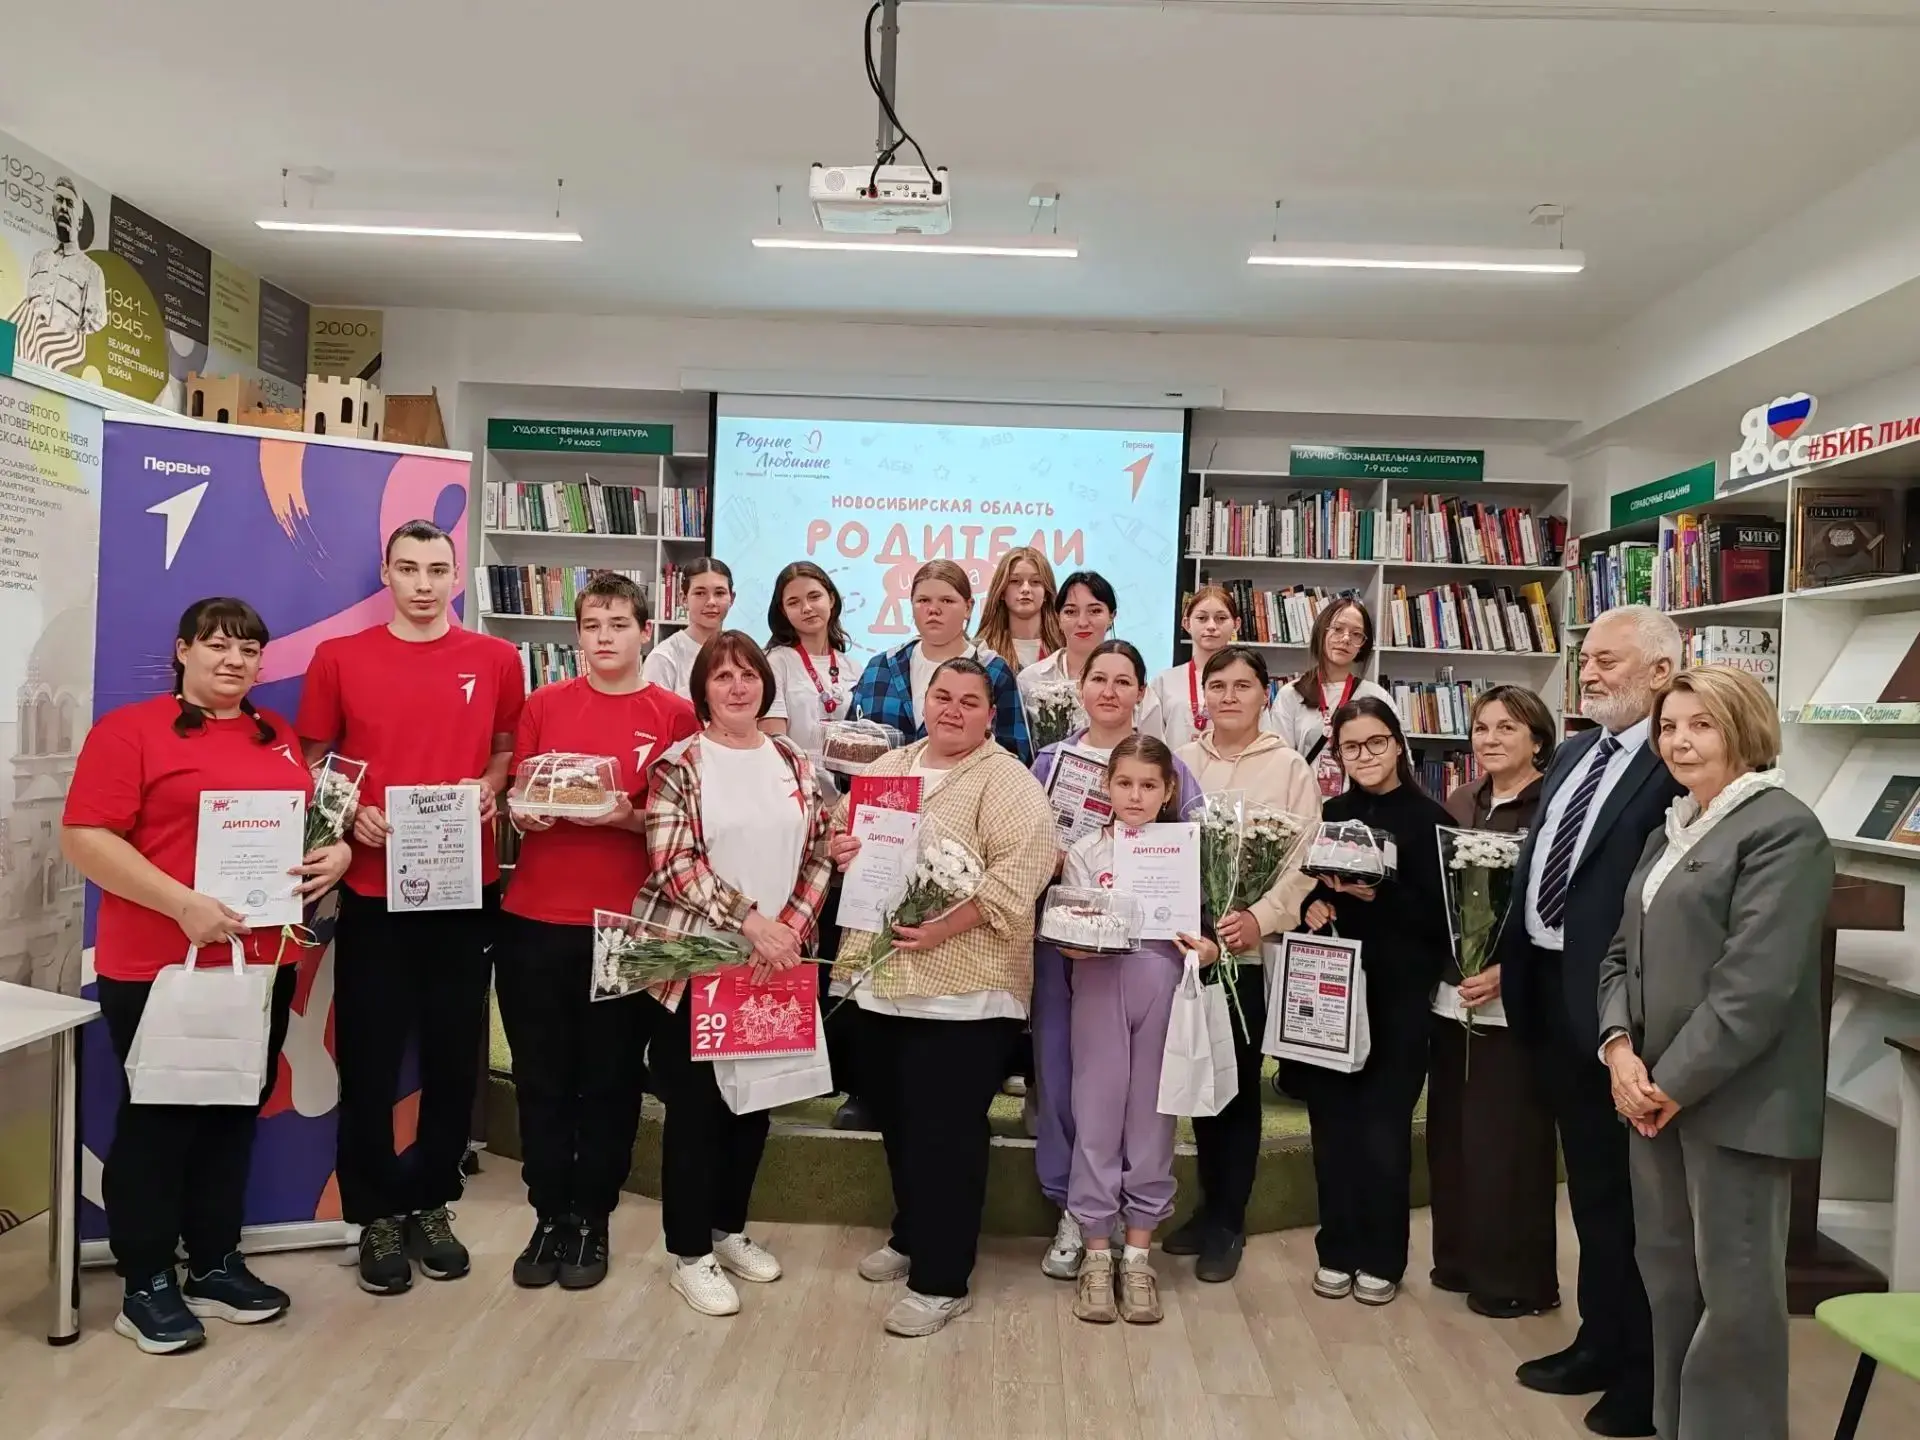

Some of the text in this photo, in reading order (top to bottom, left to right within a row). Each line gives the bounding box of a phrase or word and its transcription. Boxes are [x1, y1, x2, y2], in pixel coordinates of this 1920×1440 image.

[107, 309, 143, 338] 1945
[315, 320, 368, 336] 2000
[108, 336, 140, 357] ВЕЛИКАЯ
[107, 364, 132, 381] ВОЙНА
[108, 351, 165, 380] ОТЕЧЕСТВЕННАЯ
[18, 400, 60, 422] СВЯТОГО
[512, 425, 649, 438] ХУДОЖЕСТВЕННАЯ ЛИТЕРАТУРА
[1740, 403, 1769, 446] Я
[60, 429, 88, 447] КНЯЗЯ
[558, 438, 573, 446] 7-9
[735, 431, 792, 453] Родные
[53, 445, 99, 466] НЕВСКОГО
[756, 451, 831, 469] Любимые
[1296, 451, 1478, 464] НАУЧНО-ПОЗНАВАТЕЛЬНАЯ ЛИТЕРАТУРА
[144, 456, 211, 476] Первые
[1363, 464, 1409, 474] 7-9 класс
[831, 495, 1055, 517] НОВОСИБИРСКАЯ ОБЛАСТЬ
[806, 518, 1084, 567] РОДИТЕЛИ
[1739, 530, 1780, 543] КИНО
[1738, 629, 1752, 644] Я
[1812, 706, 1832, 720] Моя
[1864, 706, 1902, 720] Родина
[409, 792, 457, 807] Правила
[417, 803, 452, 815] мамы
[222, 820, 281, 829] ДИПЛОМ
[868, 832, 905, 846] ДИПЛОМ
[1326, 950, 1349, 960] ДОМА
[696, 1013, 727, 1031] 20
[696, 1031, 727, 1050] 27
